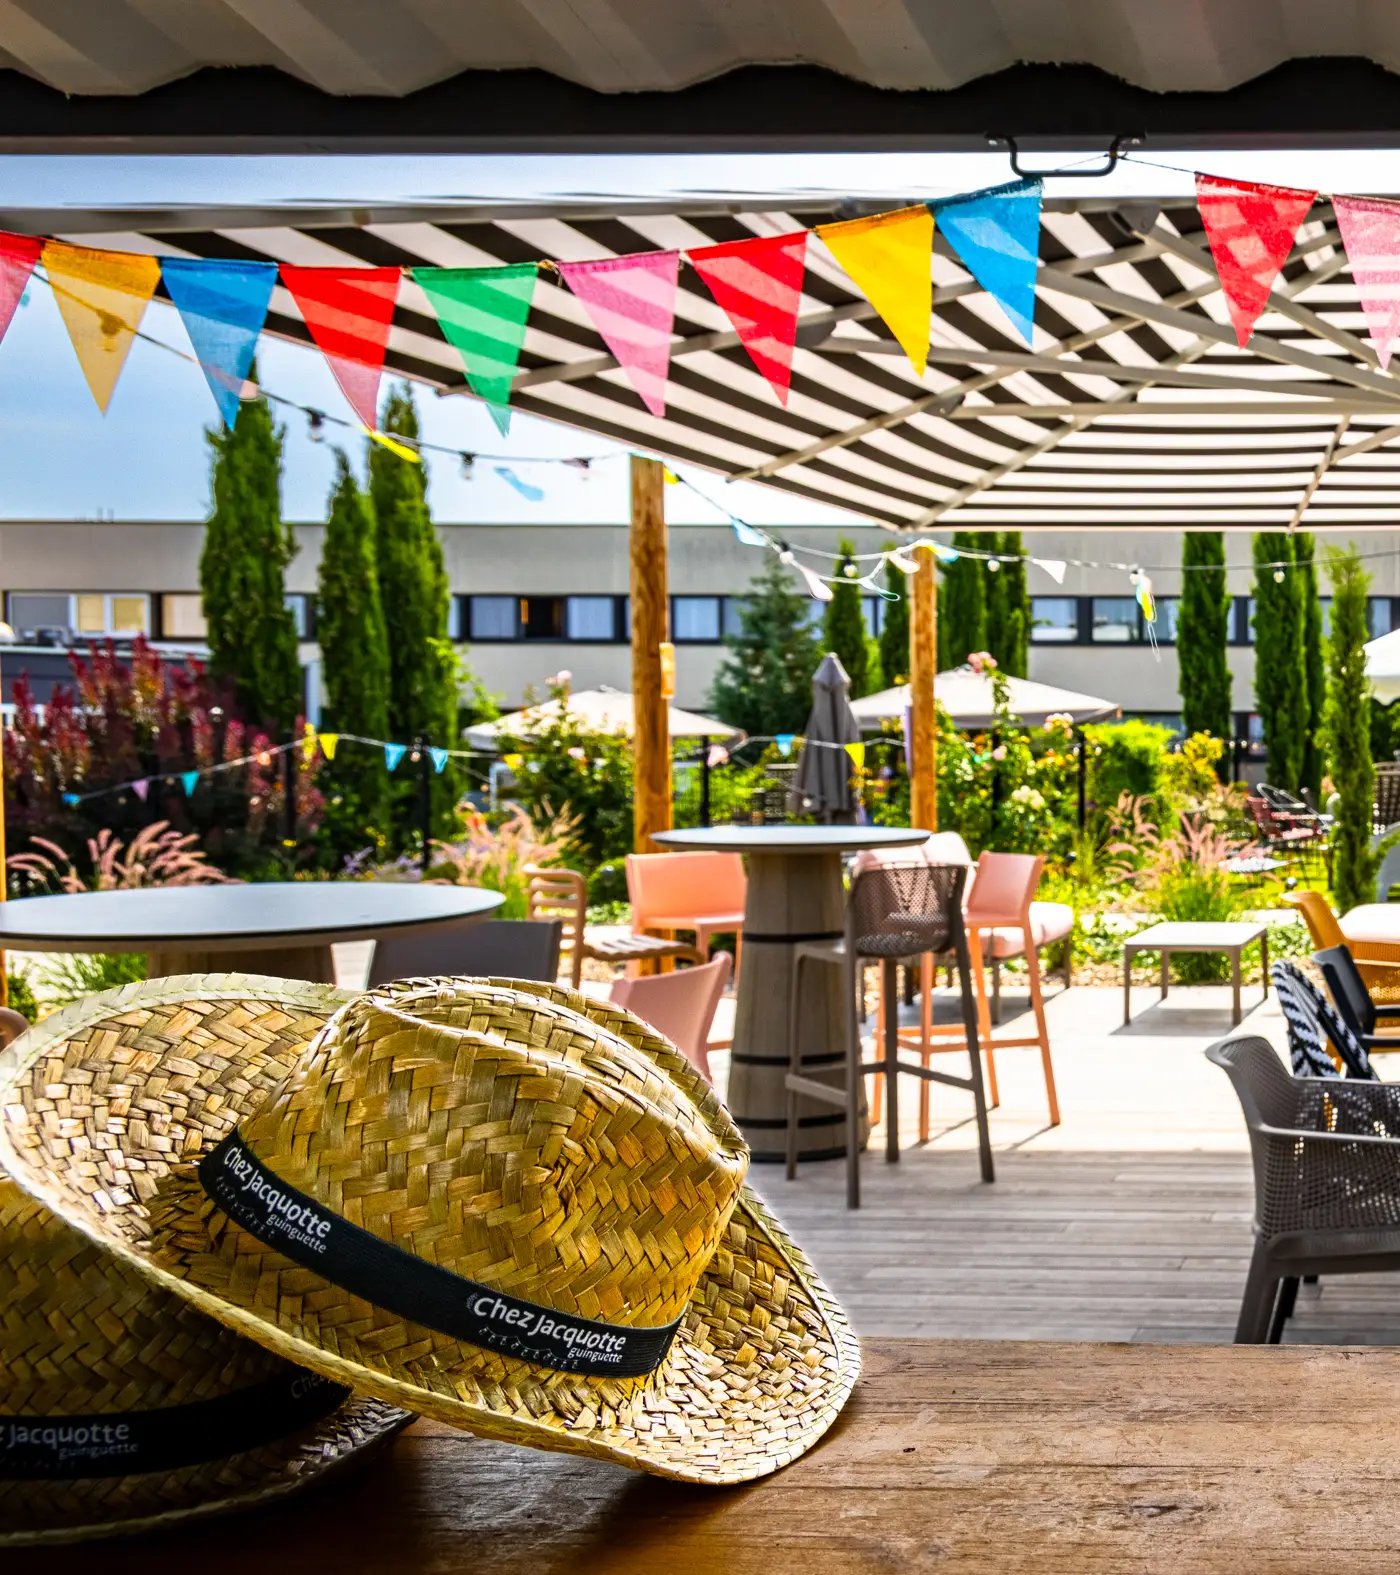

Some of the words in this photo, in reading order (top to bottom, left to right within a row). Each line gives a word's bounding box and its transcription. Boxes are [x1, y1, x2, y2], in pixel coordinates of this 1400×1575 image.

[224, 1146, 253, 1182] Chez
[241, 1169, 332, 1238] Jacquotte
[265, 1213, 327, 1254] guinguette
[473, 1297, 535, 1328] Chez
[527, 1314, 627, 1352] Jacquotte
[567, 1346, 623, 1363] guinguette
[290, 1371, 324, 1399] Che
[6, 1423, 130, 1450] Jacquotte
[58, 1443, 139, 1460] guinguette
